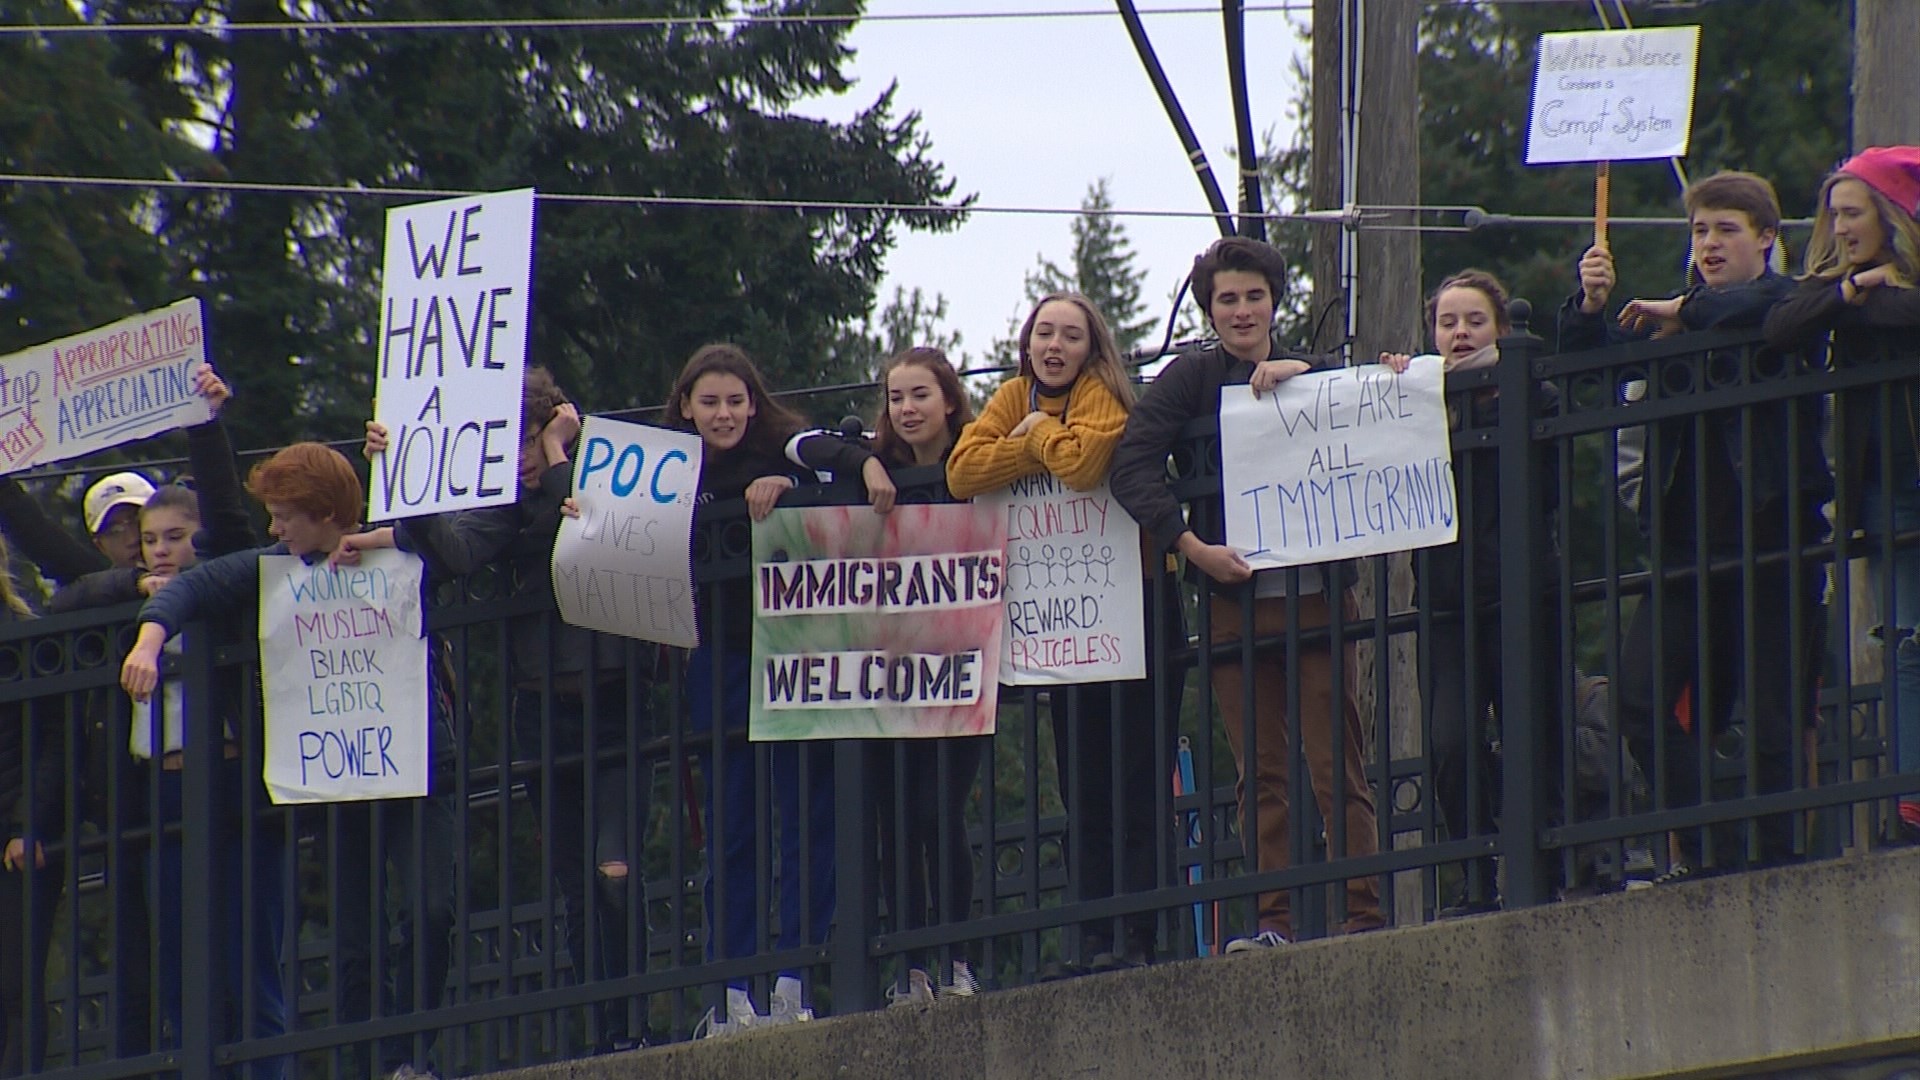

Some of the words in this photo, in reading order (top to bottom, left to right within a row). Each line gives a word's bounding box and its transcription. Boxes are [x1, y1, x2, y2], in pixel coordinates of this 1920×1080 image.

[1544, 37, 1606, 71] White
[1616, 34, 1681, 67] Silence
[1539, 98, 1609, 145] Corrupt
[1612, 96, 1671, 142] System
[406, 204, 483, 280] WE
[52, 312, 201, 398] APPROPRIATING
[382, 286, 513, 380] HAVE
[417, 384, 442, 425] A
[1272, 376, 1350, 437] WE
[1356, 372, 1414, 427] ARE
[381, 419, 508, 513] VOICE
[1306, 442, 1365, 476] ALL
[581, 506, 659, 556] LIVES
[1240, 456, 1455, 558] IMMIGRANTS
[555, 560, 695, 638] MATTER
[760, 555, 1001, 611] IMMIGRANTS
[294, 607, 394, 648] MUSLIM
[1010, 632, 1122, 672] PRICELESS
[310, 648, 384, 680] BLACK
[766, 653, 976, 704] WELCOME
[308, 680, 385, 716] LGBTQ
[299, 725, 399, 786] POWER
